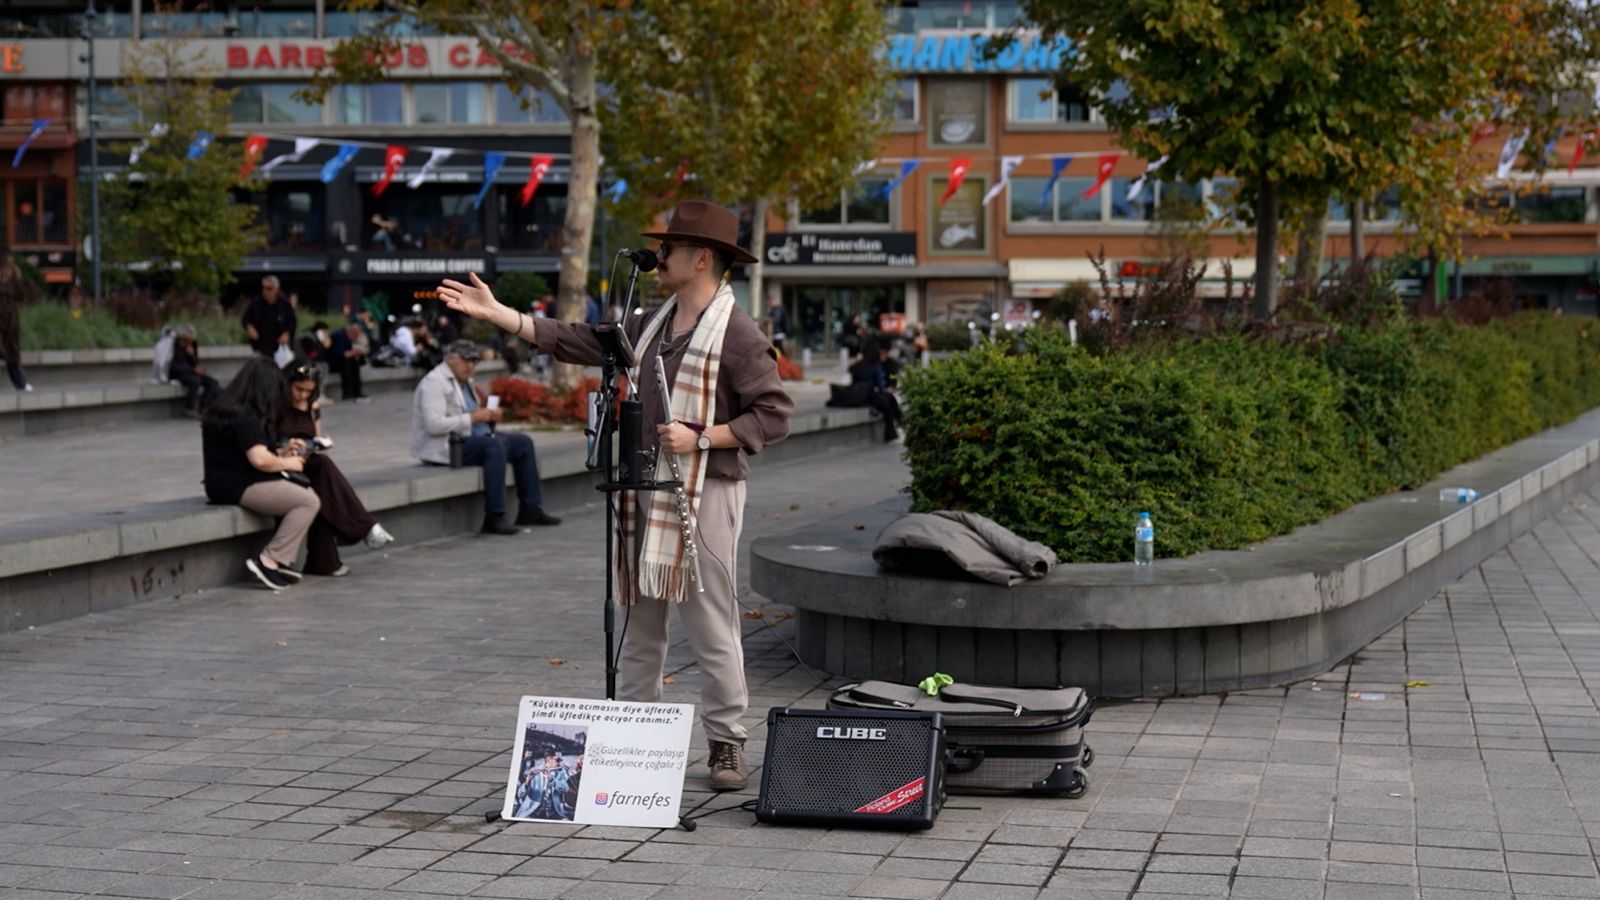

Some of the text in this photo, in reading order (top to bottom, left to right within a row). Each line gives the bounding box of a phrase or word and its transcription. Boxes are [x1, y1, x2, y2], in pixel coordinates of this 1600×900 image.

[226, 45, 428, 69] BARBOS
[622, 705, 642, 715] diye
[816, 726, 887, 740] CUBE
[607, 790, 672, 810] farnefes
